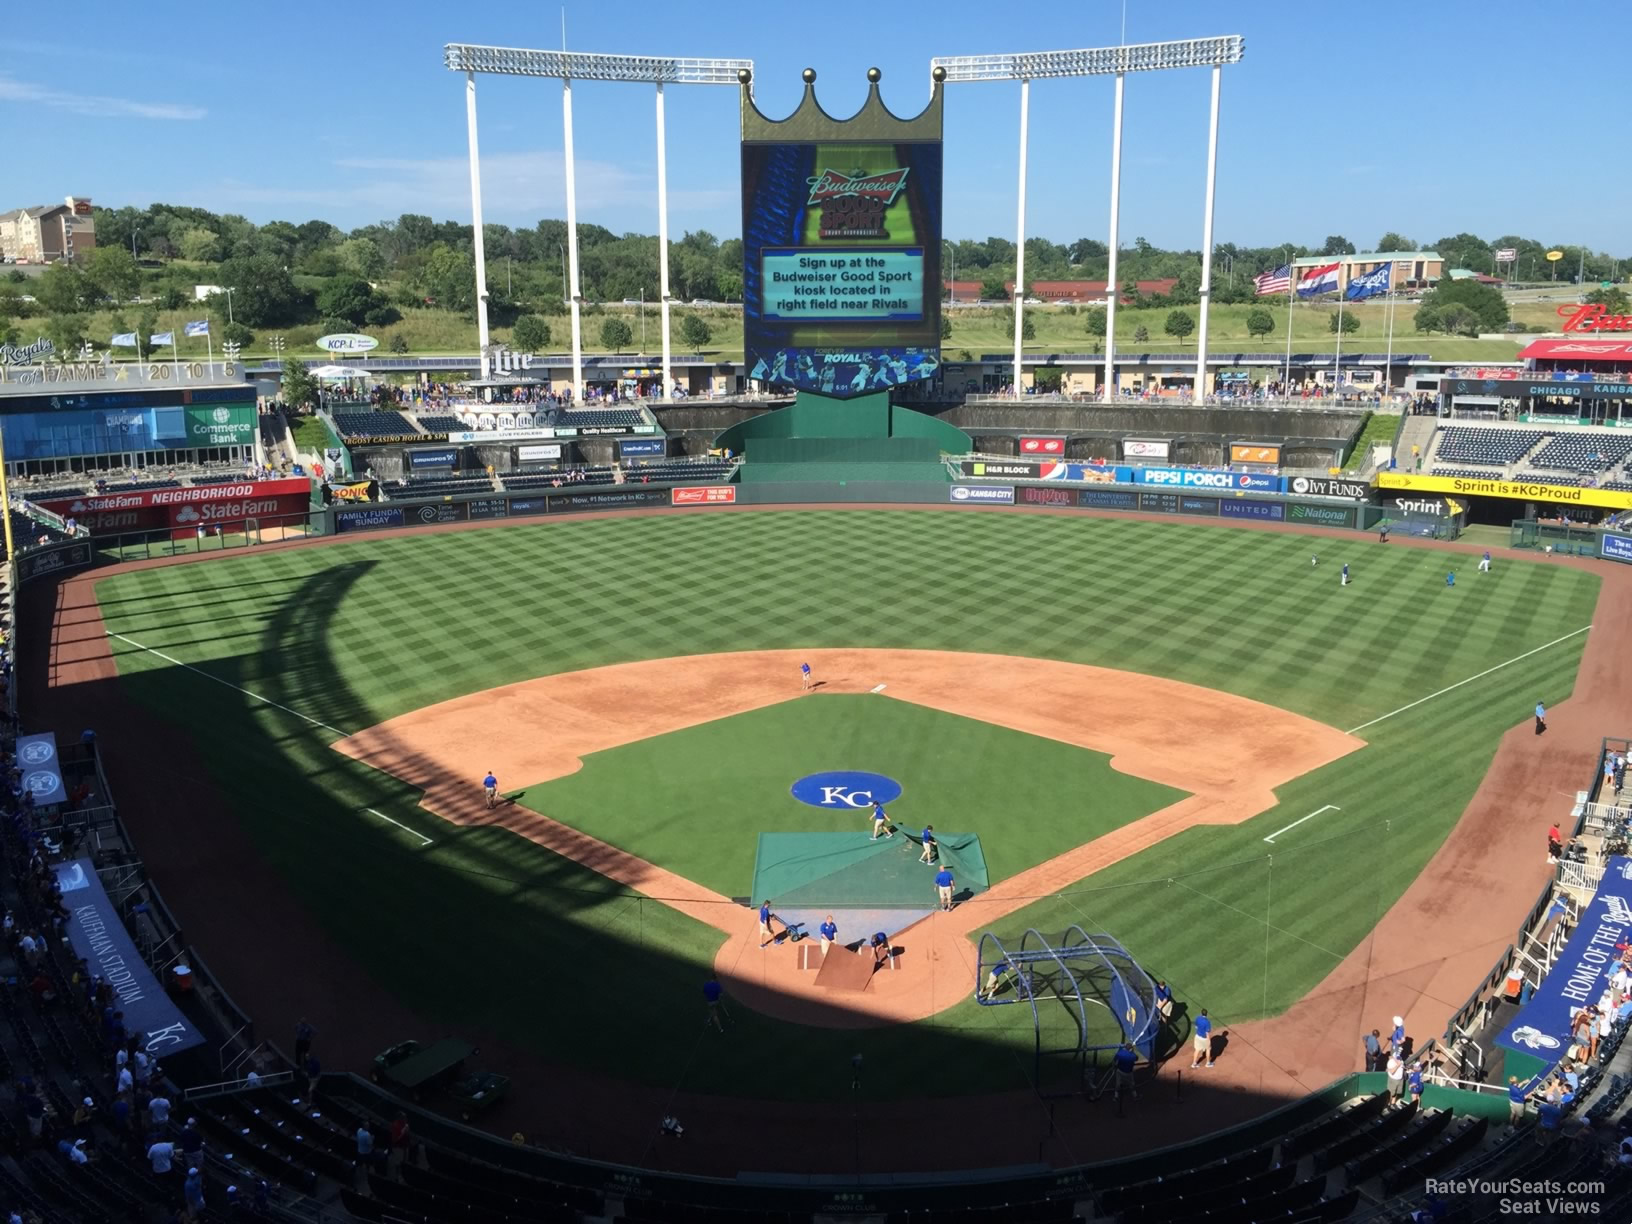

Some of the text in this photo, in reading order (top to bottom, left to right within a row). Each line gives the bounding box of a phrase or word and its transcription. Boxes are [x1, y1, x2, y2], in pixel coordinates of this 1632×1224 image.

[806, 176, 906, 194] Budweiser
[799, 257, 886, 270] Sign up at the
[773, 271, 912, 284] Budweiser Good Sport
[794, 285, 891, 295] kiosk located in
[776, 299, 908, 312] right field near Rivals
[0, 336, 55, 366] Royals
[494, 350, 532, 376] Lite
[824, 354, 861, 363] ROYAL
[42, 363, 107, 383] FAME
[150, 364, 170, 380] 20
[187, 363, 204, 379] 10
[224, 362, 235, 377] 5
[1530, 386, 1580, 395] CHICAGO
[193, 423, 250, 434] Commerce
[210, 433, 237, 443] Bank
[373, 436, 400, 444] CASINO
[402, 434, 425, 442] HOTEL
[1004, 466, 1030, 474] BLOCK
[1145, 470, 1233, 487] PEPSI PORCH
[1251, 477, 1269, 486] pepsi
[1380, 477, 1401, 486] Sprint
[152, 485, 253, 504] NEIGHBORHOOD
[335, 487, 368, 498] SONIC
[970, 490, 996, 498] KANSAS
[997, 491, 1013, 499] CITY
[1309, 480, 1364, 497] IVY FUNDS
[1454, 479, 1581, 500] Sprint is #KCProud
[1225, 505, 1268, 515] UNITED
[1396, 497, 1442, 516] Sprint
[1555, 505, 1594, 520] Sprint
[338, 508, 403, 521] FAMILY FUNDAY
[1304, 507, 1346, 520] National
[355, 516, 389, 526] SUNDAY
[820, 786, 874, 808] KC
[75, 904, 145, 1005] KAUFFMAN STADIUM
[1562, 894, 1632, 1002] HOME OF THE Royals
[145, 1022, 186, 1052] KC
